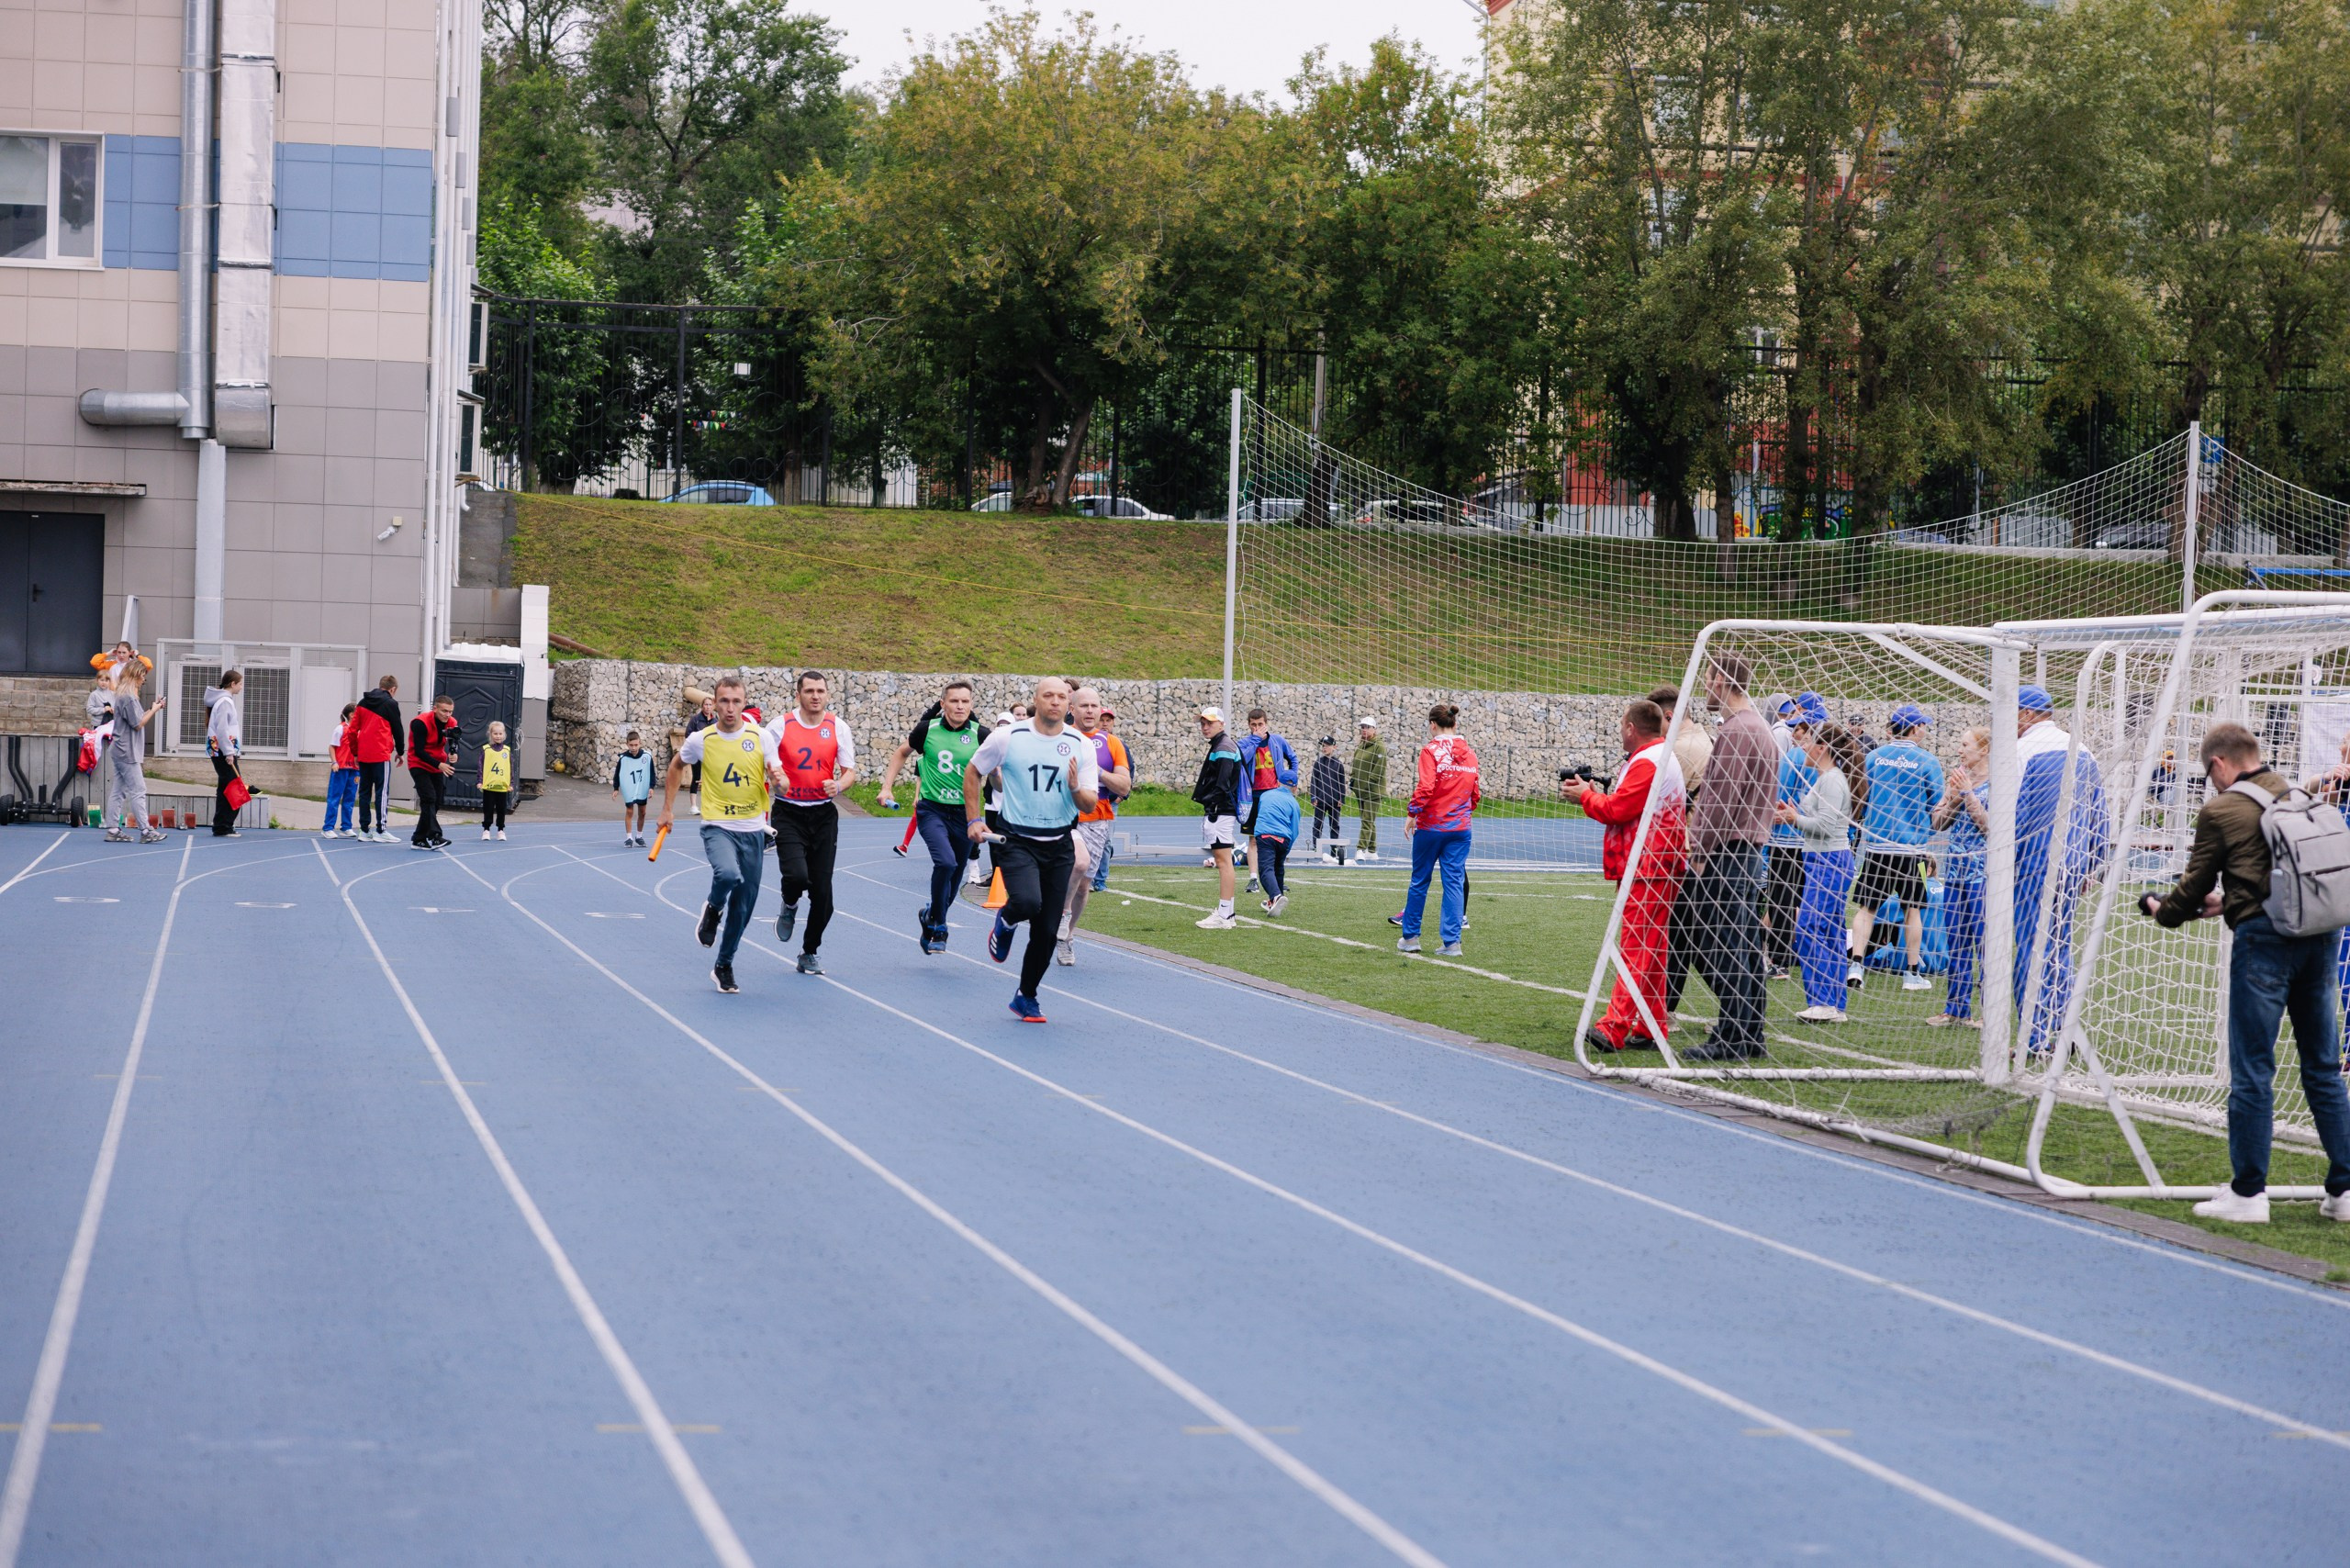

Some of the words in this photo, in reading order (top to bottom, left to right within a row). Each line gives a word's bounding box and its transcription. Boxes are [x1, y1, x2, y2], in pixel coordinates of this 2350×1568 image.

[491, 763, 499, 775] 4
[797, 747, 813, 770] 2
[937, 750, 954, 773] 8
[1874, 757, 1919, 769] Созвездие
[722, 762, 742, 788] 4
[1028, 764, 1059, 792] 17
